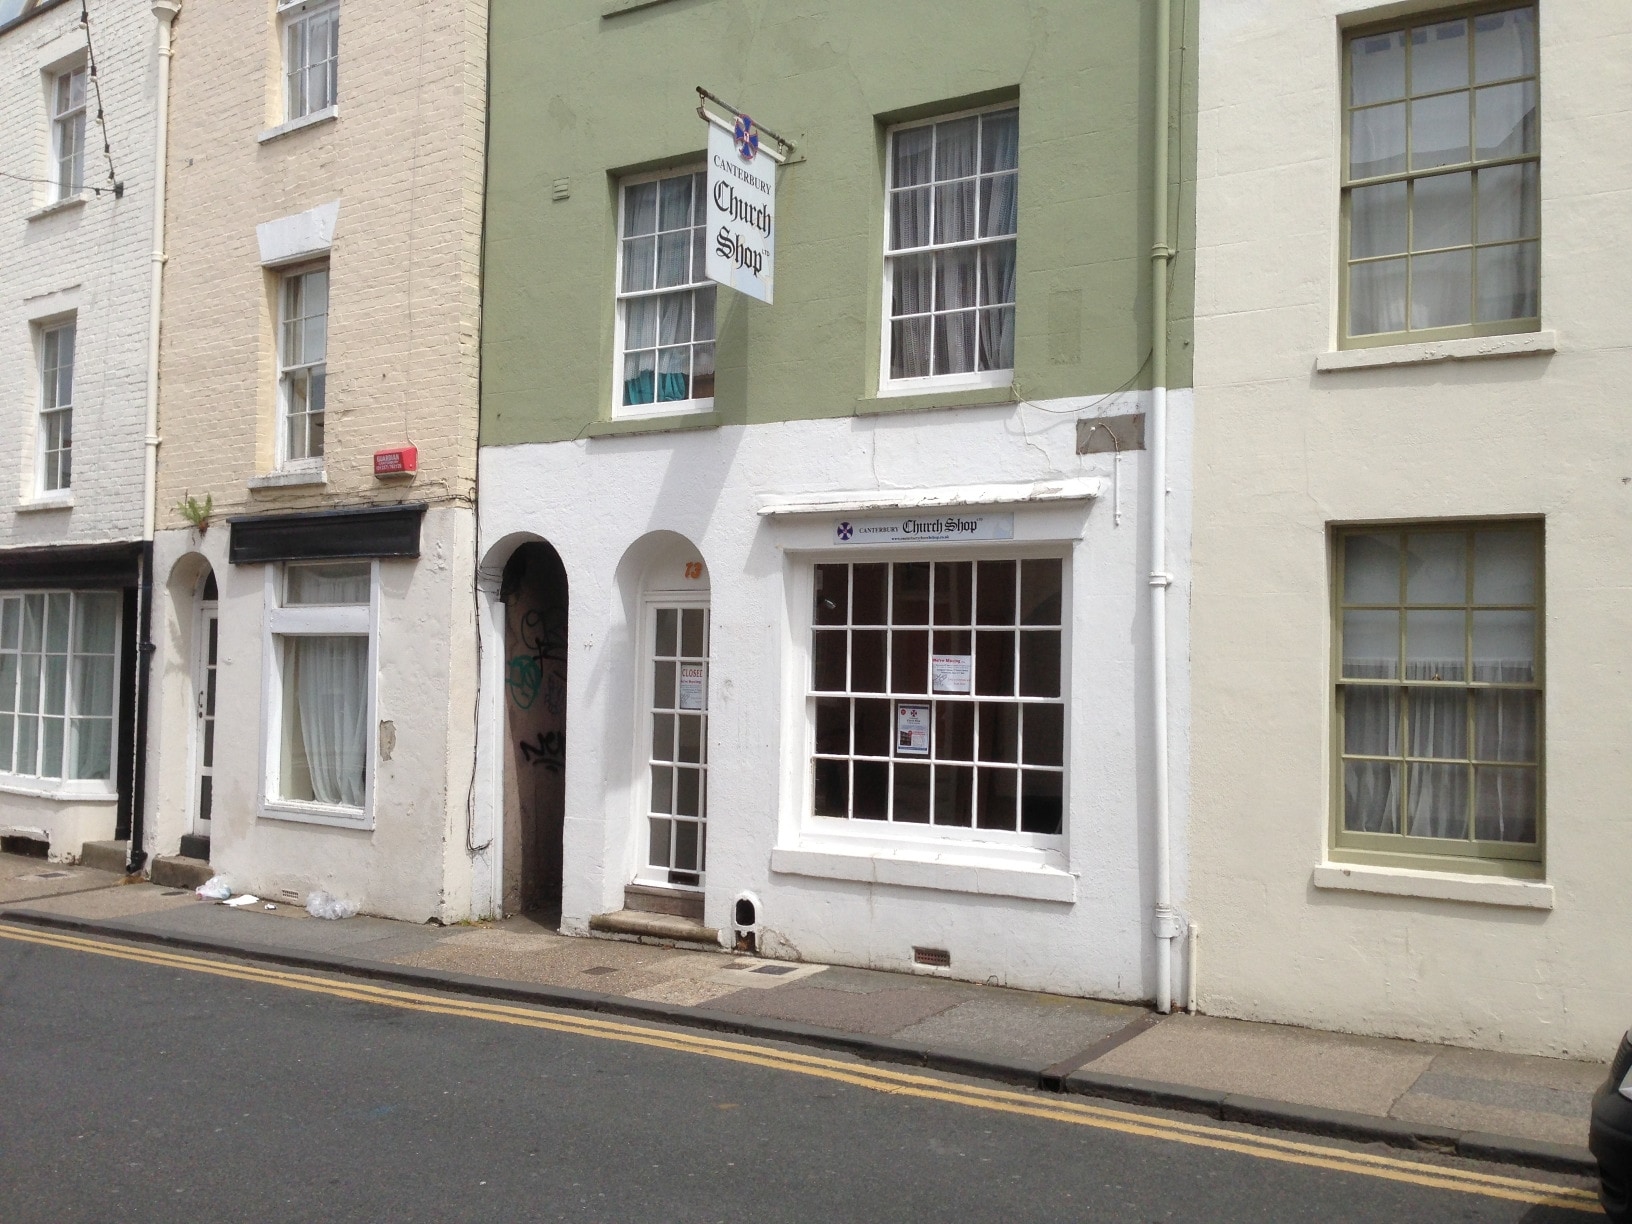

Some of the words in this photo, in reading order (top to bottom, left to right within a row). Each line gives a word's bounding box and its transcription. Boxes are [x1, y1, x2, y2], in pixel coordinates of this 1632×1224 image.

[713, 154, 772, 196] CANTERBURY
[713, 179, 771, 239] Church
[715, 225, 762, 278] Shop
[858, 526, 899, 534] CANTERBURY
[902, 519, 943, 535] Church
[944, 517, 978, 534] Shop
